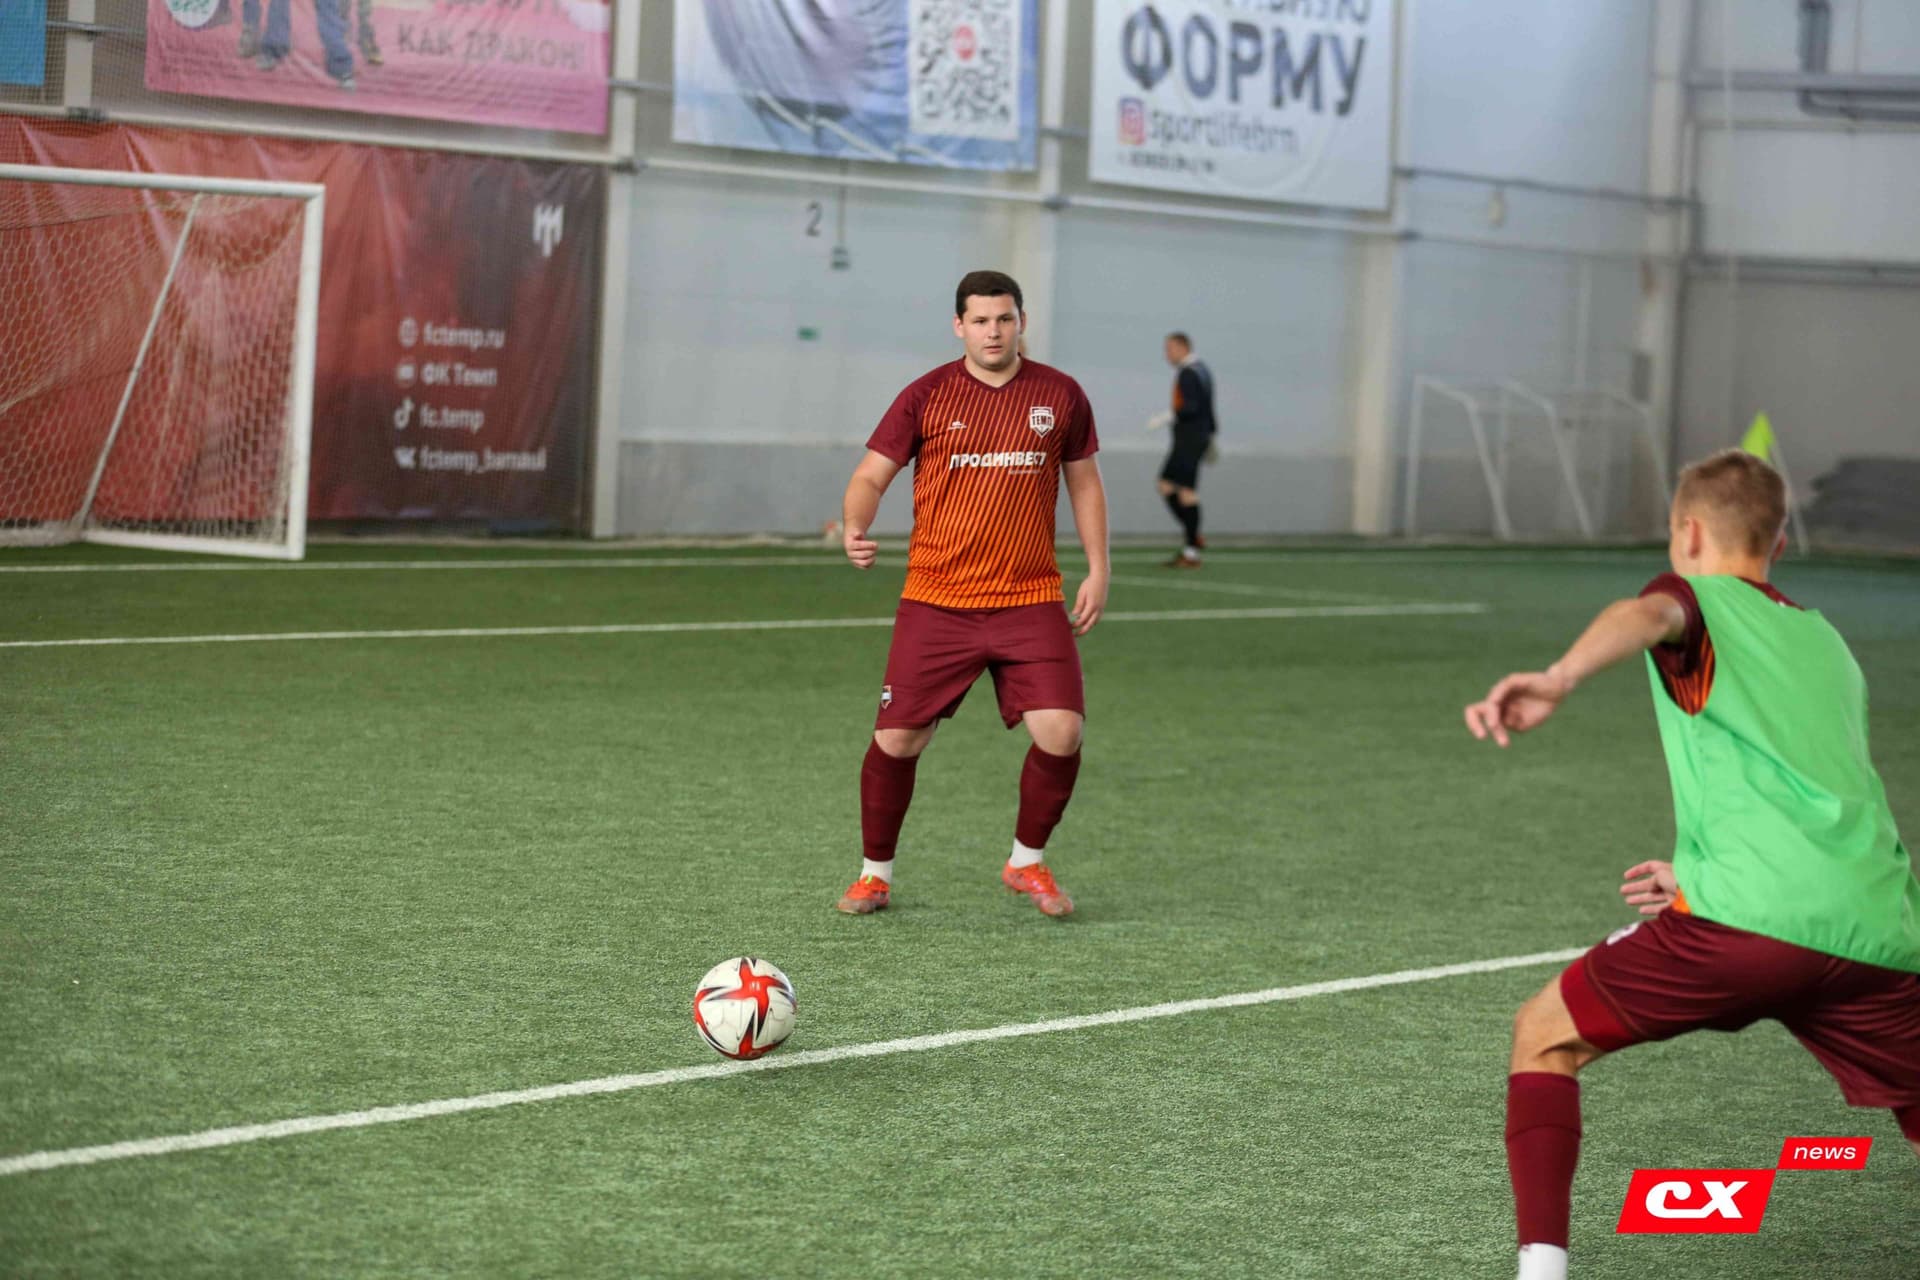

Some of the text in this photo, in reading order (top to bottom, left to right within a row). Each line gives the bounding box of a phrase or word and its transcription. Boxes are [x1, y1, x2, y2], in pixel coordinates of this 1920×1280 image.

[397, 23, 453, 56] КАК
[1121, 6, 1367, 116] ФОРМУ
[805, 201, 822, 238] 2
[421, 362, 449, 385] ФК
[949, 450, 1047, 471] ПРОДИНВЕСТ
